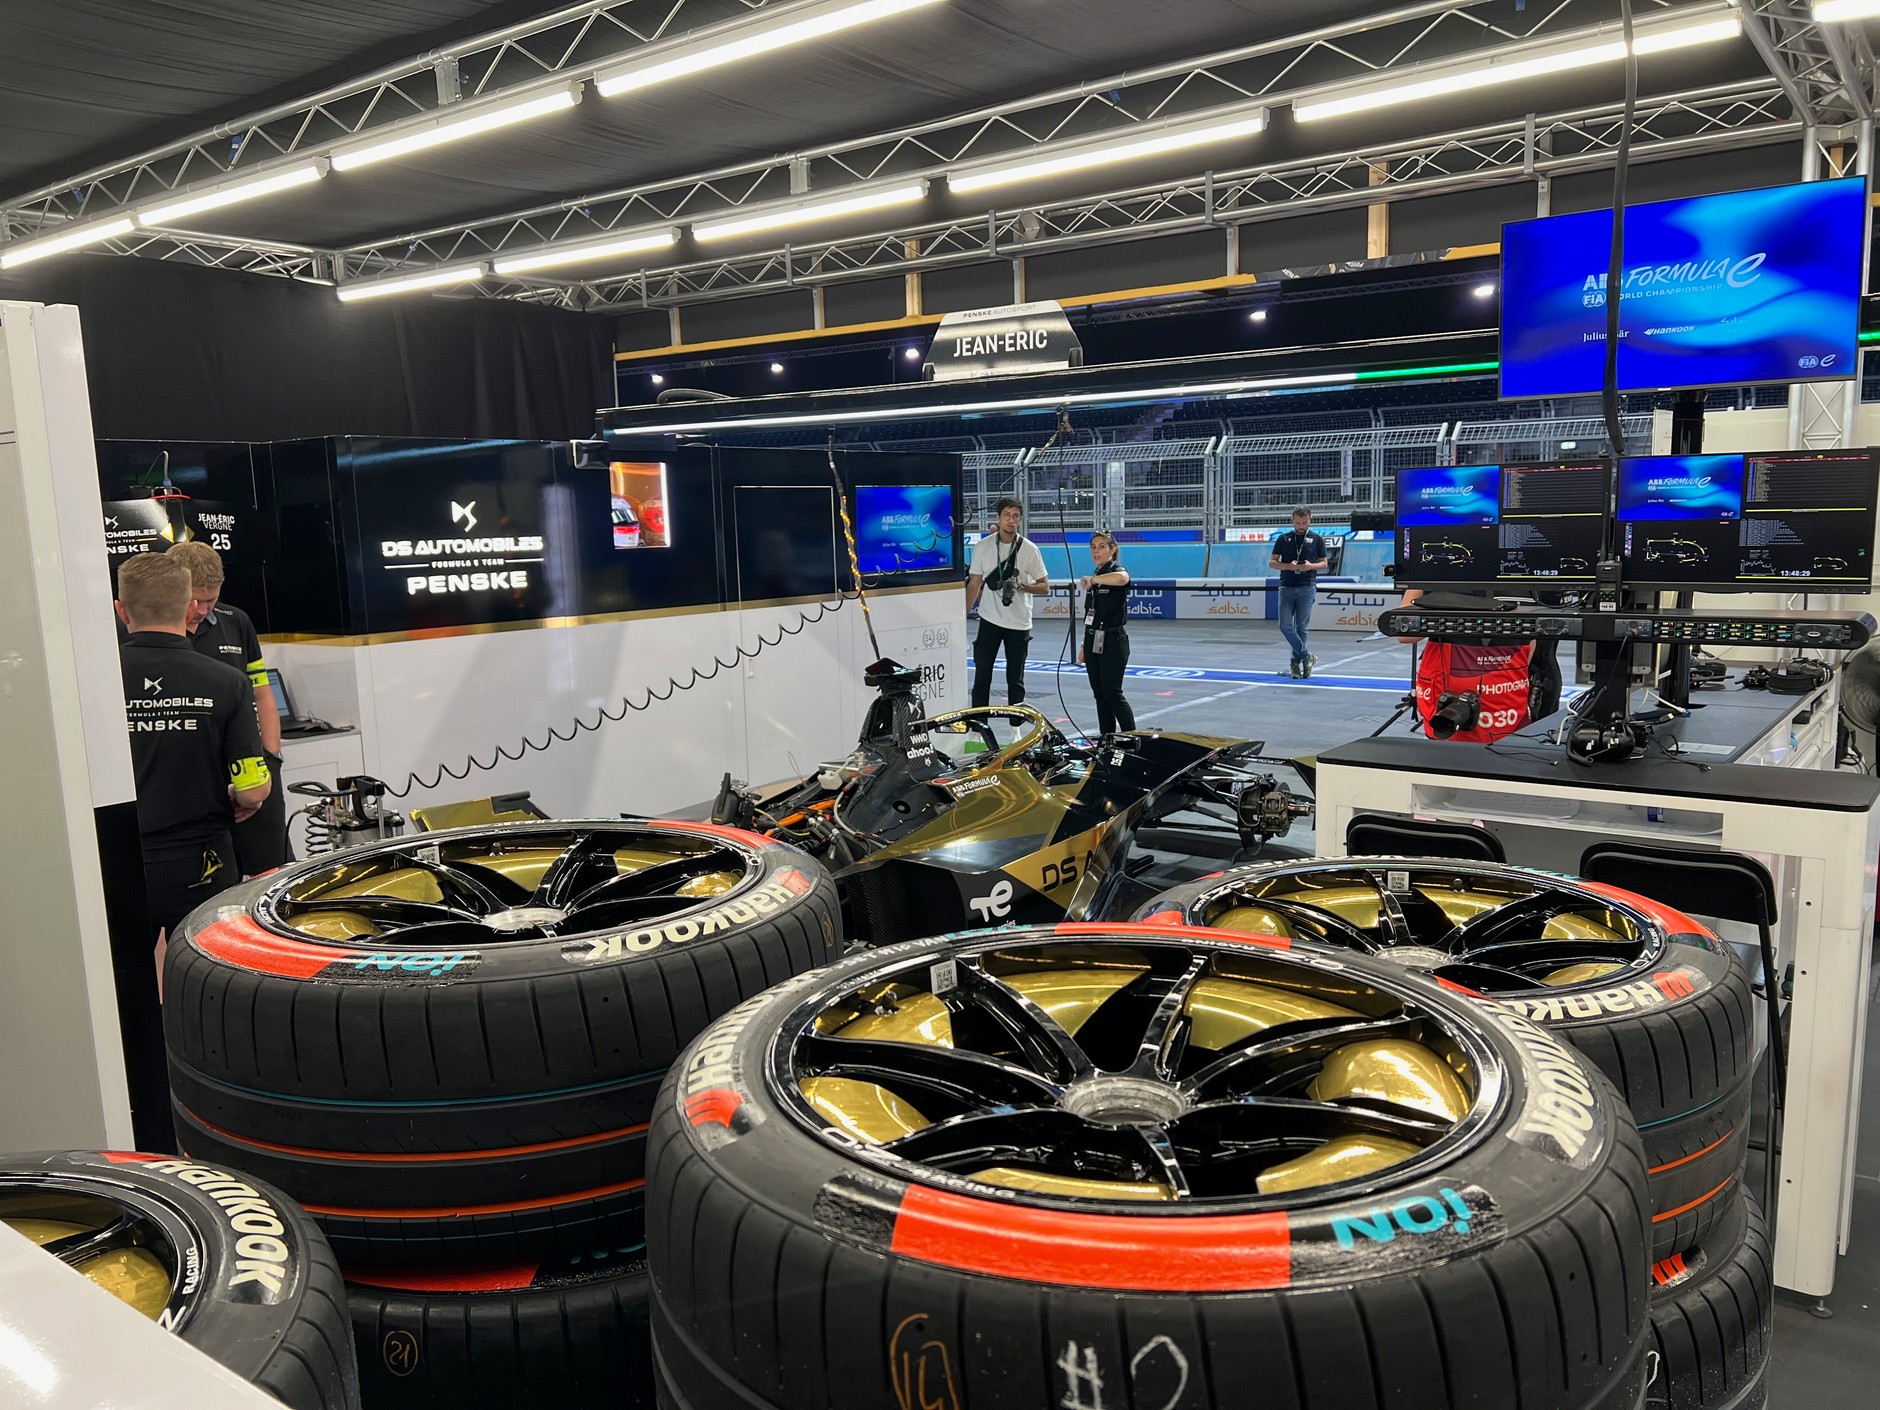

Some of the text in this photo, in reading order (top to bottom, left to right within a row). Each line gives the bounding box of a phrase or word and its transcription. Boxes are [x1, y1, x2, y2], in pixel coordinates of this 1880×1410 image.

[1626, 257, 1731, 289] FORMULA
[1620, 284, 1723, 300] ORLD CHAMPIONSHIP
[963, 304, 1036, 318] PENSKE AUTOSPORT
[202, 521, 233, 531] VERGNE
[107, 544, 149, 554] NSKE
[211, 532, 231, 550] 25
[381, 536, 543, 557] DS AUTOMOBILES
[481, 558, 504, 566] TEAM
[407, 570, 528, 595] PENSKE
[964, 777, 991, 790] FORMULA
[1042, 856, 1078, 893] DS
[912, 1168, 1017, 1199] RACING
[182, 1246, 199, 1295] RACING
